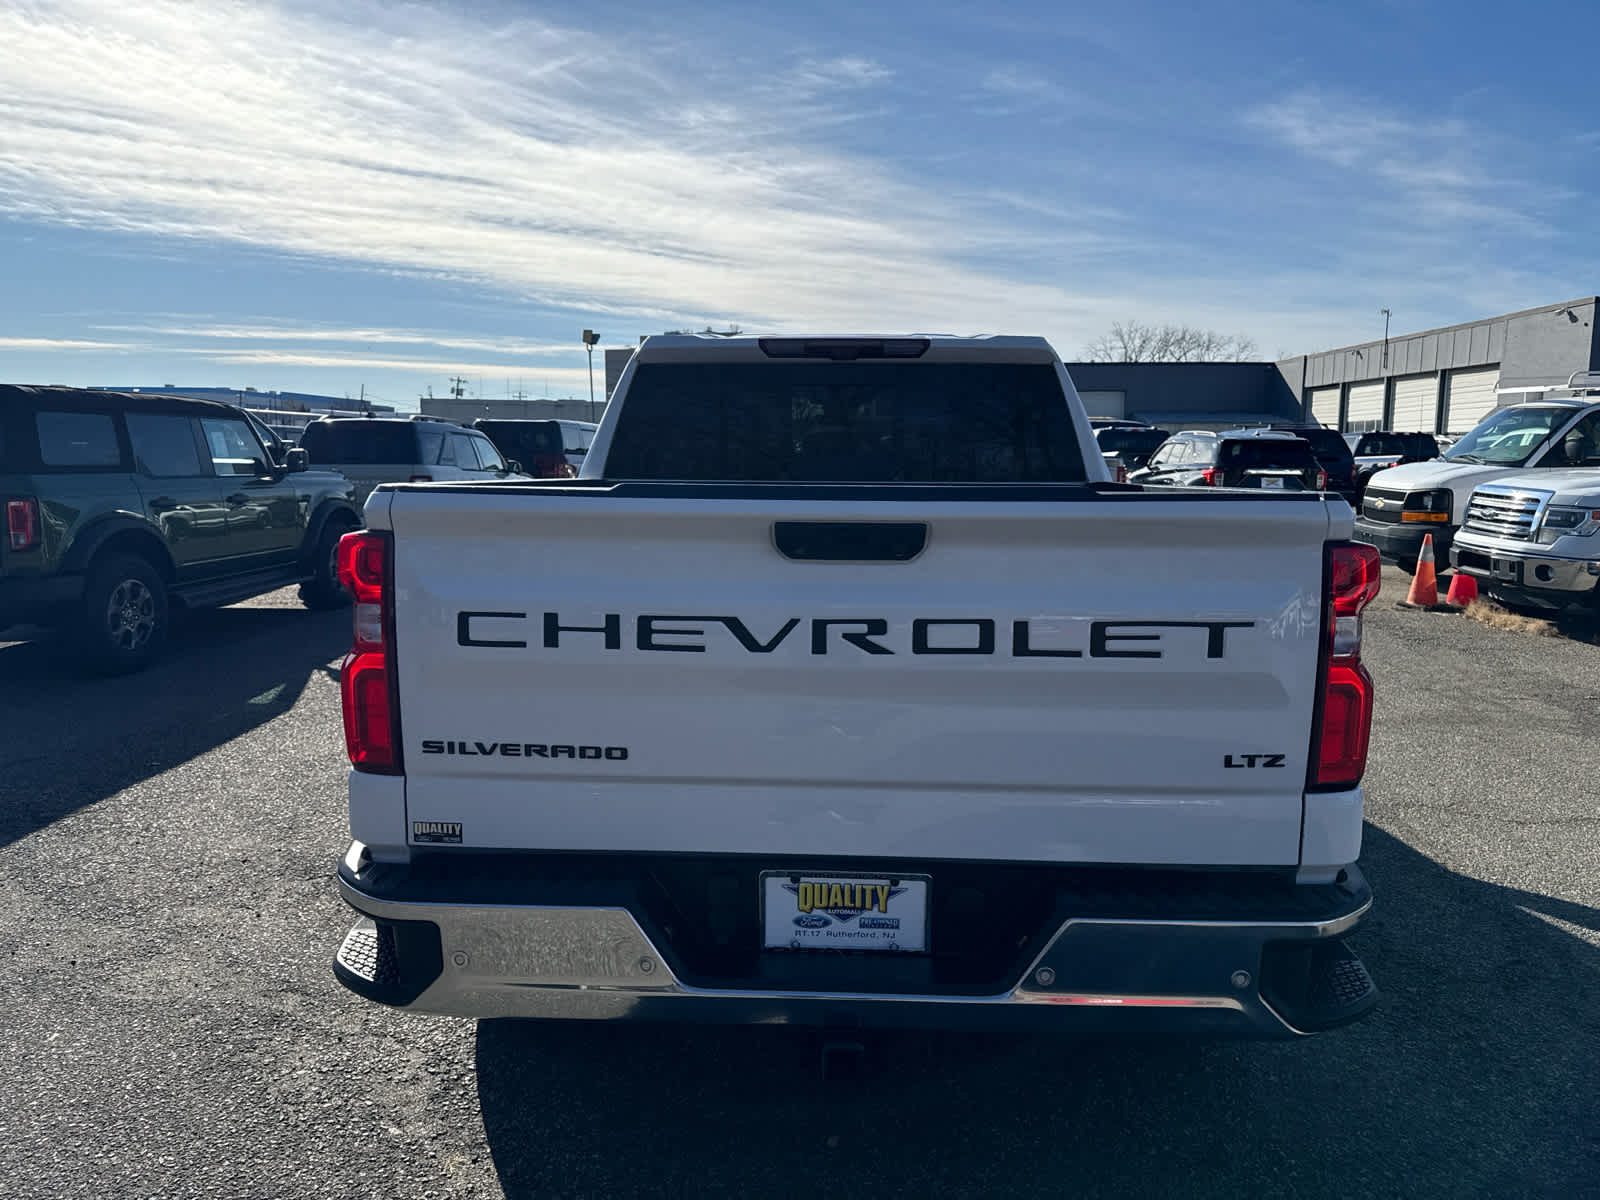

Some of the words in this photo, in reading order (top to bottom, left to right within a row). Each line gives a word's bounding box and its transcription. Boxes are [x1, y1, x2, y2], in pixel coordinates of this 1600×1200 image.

[457, 610, 1255, 660] CHEVROLET
[421, 740, 629, 761] SILVERADO
[1223, 753, 1286, 769] LTZ
[414, 822, 461, 835] QUALITY
[798, 882, 891, 914] QUALITY
[882, 931, 896, 939] NJ
